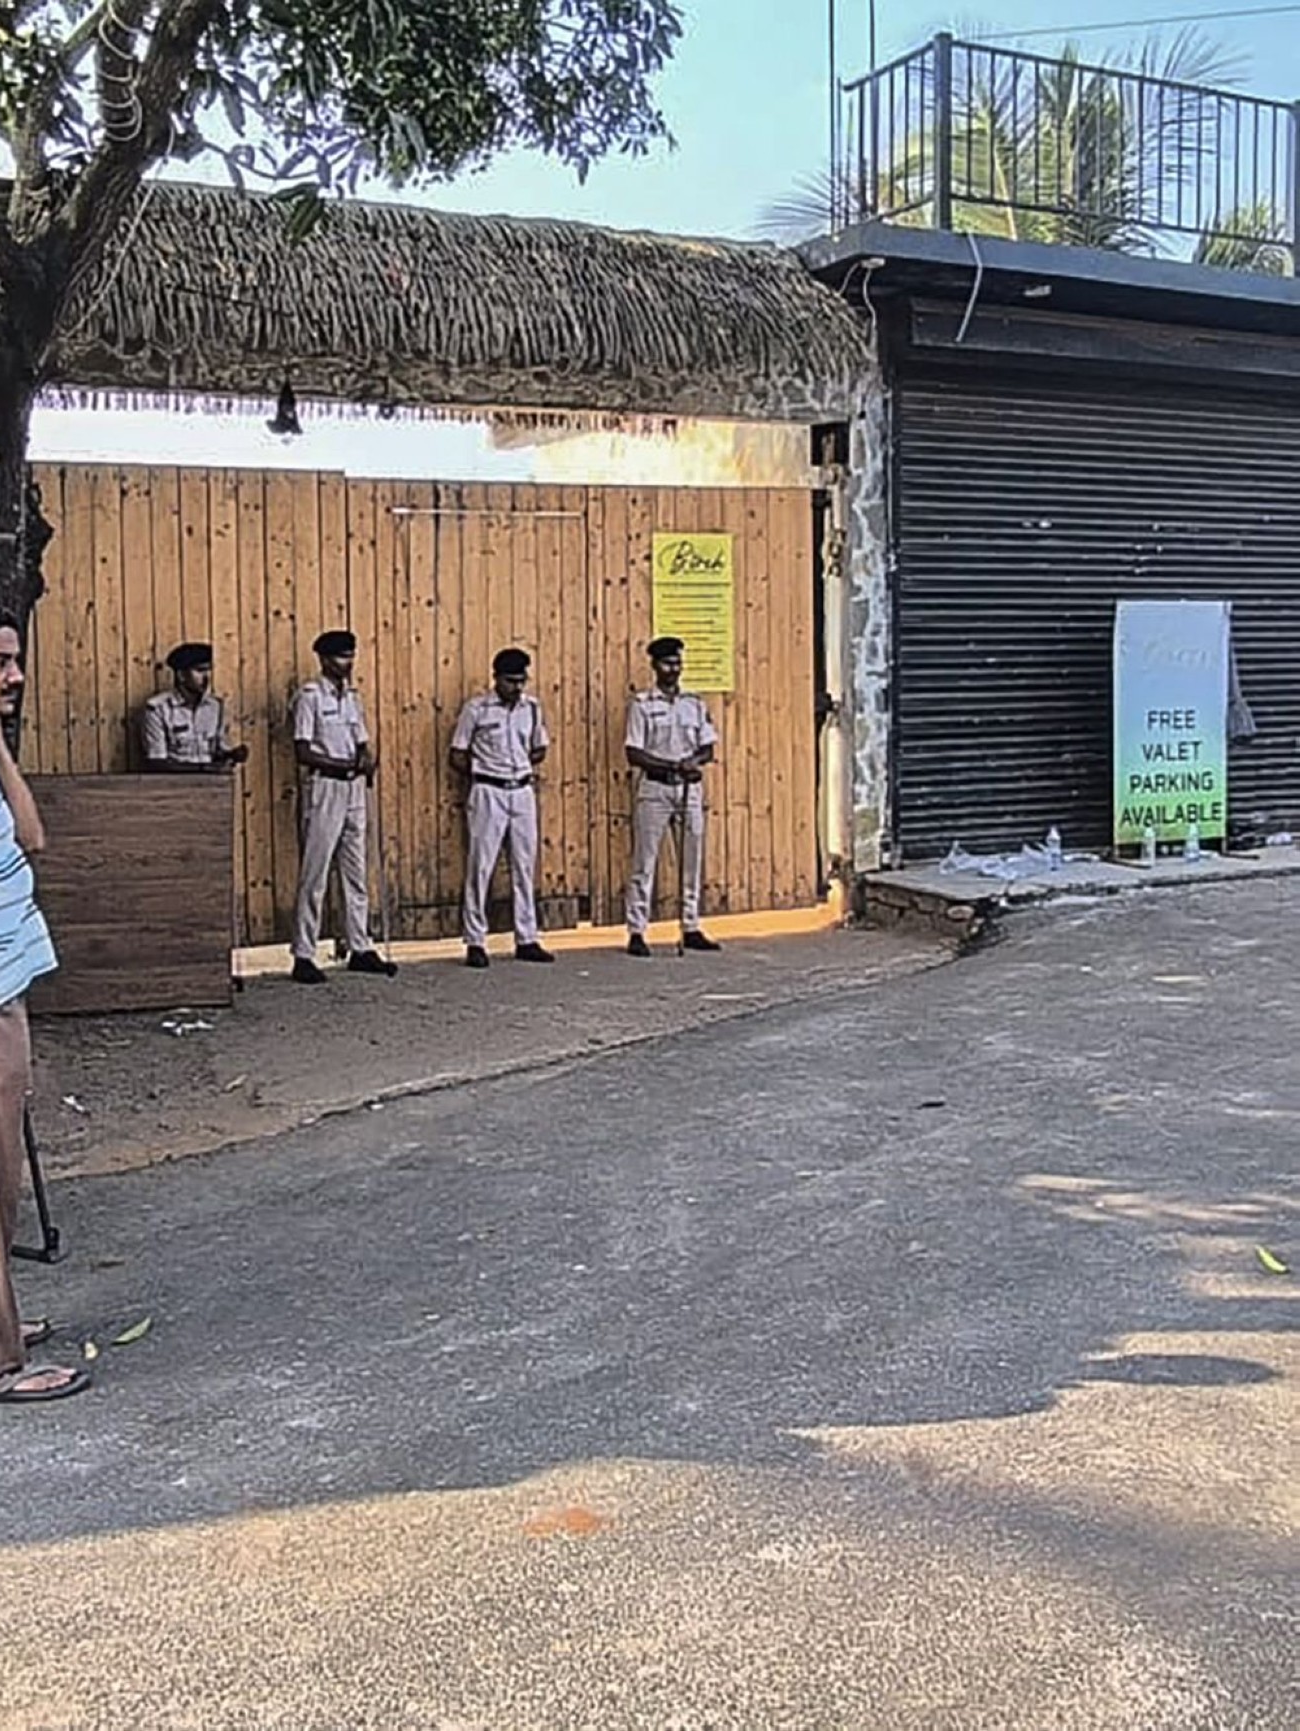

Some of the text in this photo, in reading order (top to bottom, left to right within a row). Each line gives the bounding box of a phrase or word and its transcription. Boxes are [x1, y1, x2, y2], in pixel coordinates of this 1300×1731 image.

[1147, 709, 1196, 730] FREE
[1141, 740, 1203, 762] VALET
[1129, 771, 1214, 794] PARKING
[1121, 802, 1223, 828] AVAILABLE
